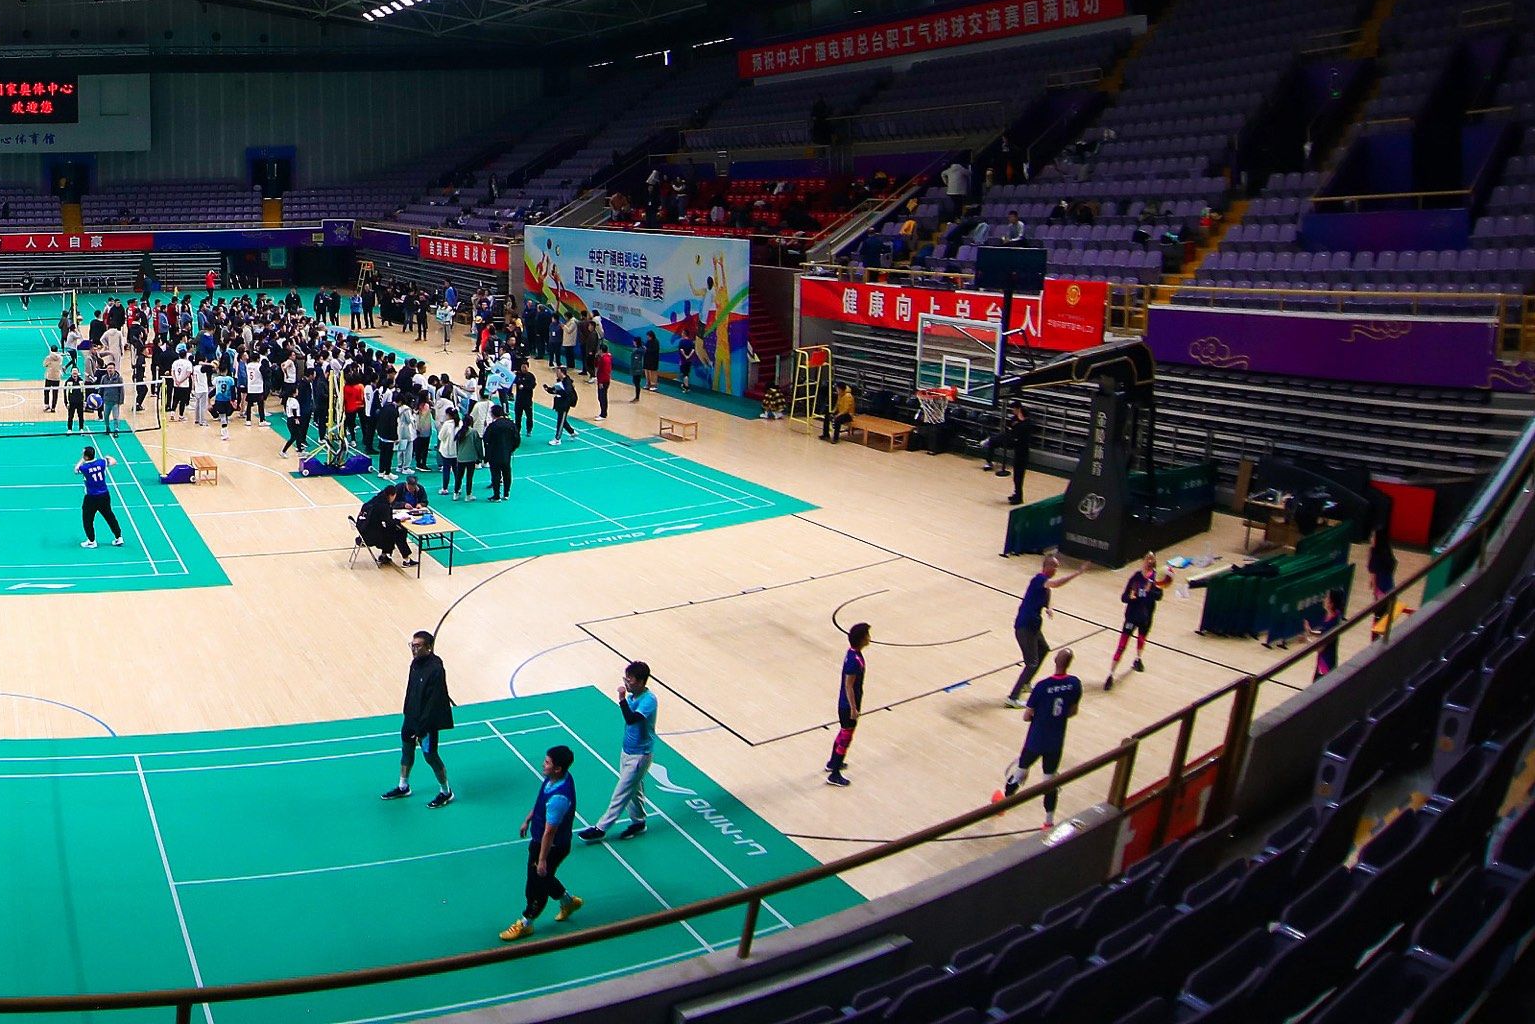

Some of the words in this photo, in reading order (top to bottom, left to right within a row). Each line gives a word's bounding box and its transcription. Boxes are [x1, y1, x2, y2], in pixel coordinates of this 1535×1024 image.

[11, 101, 55, 114] 欢迎您
[26, 235, 103, 248] 人人自豪
[588, 249, 648, 269] 中央广播电视总台
[574, 265, 664, 301] 职工气排球交流赛
[91, 472, 104, 482] 11
[1053, 697, 1064, 717] 6
[685, 798, 768, 856] LI-NING
